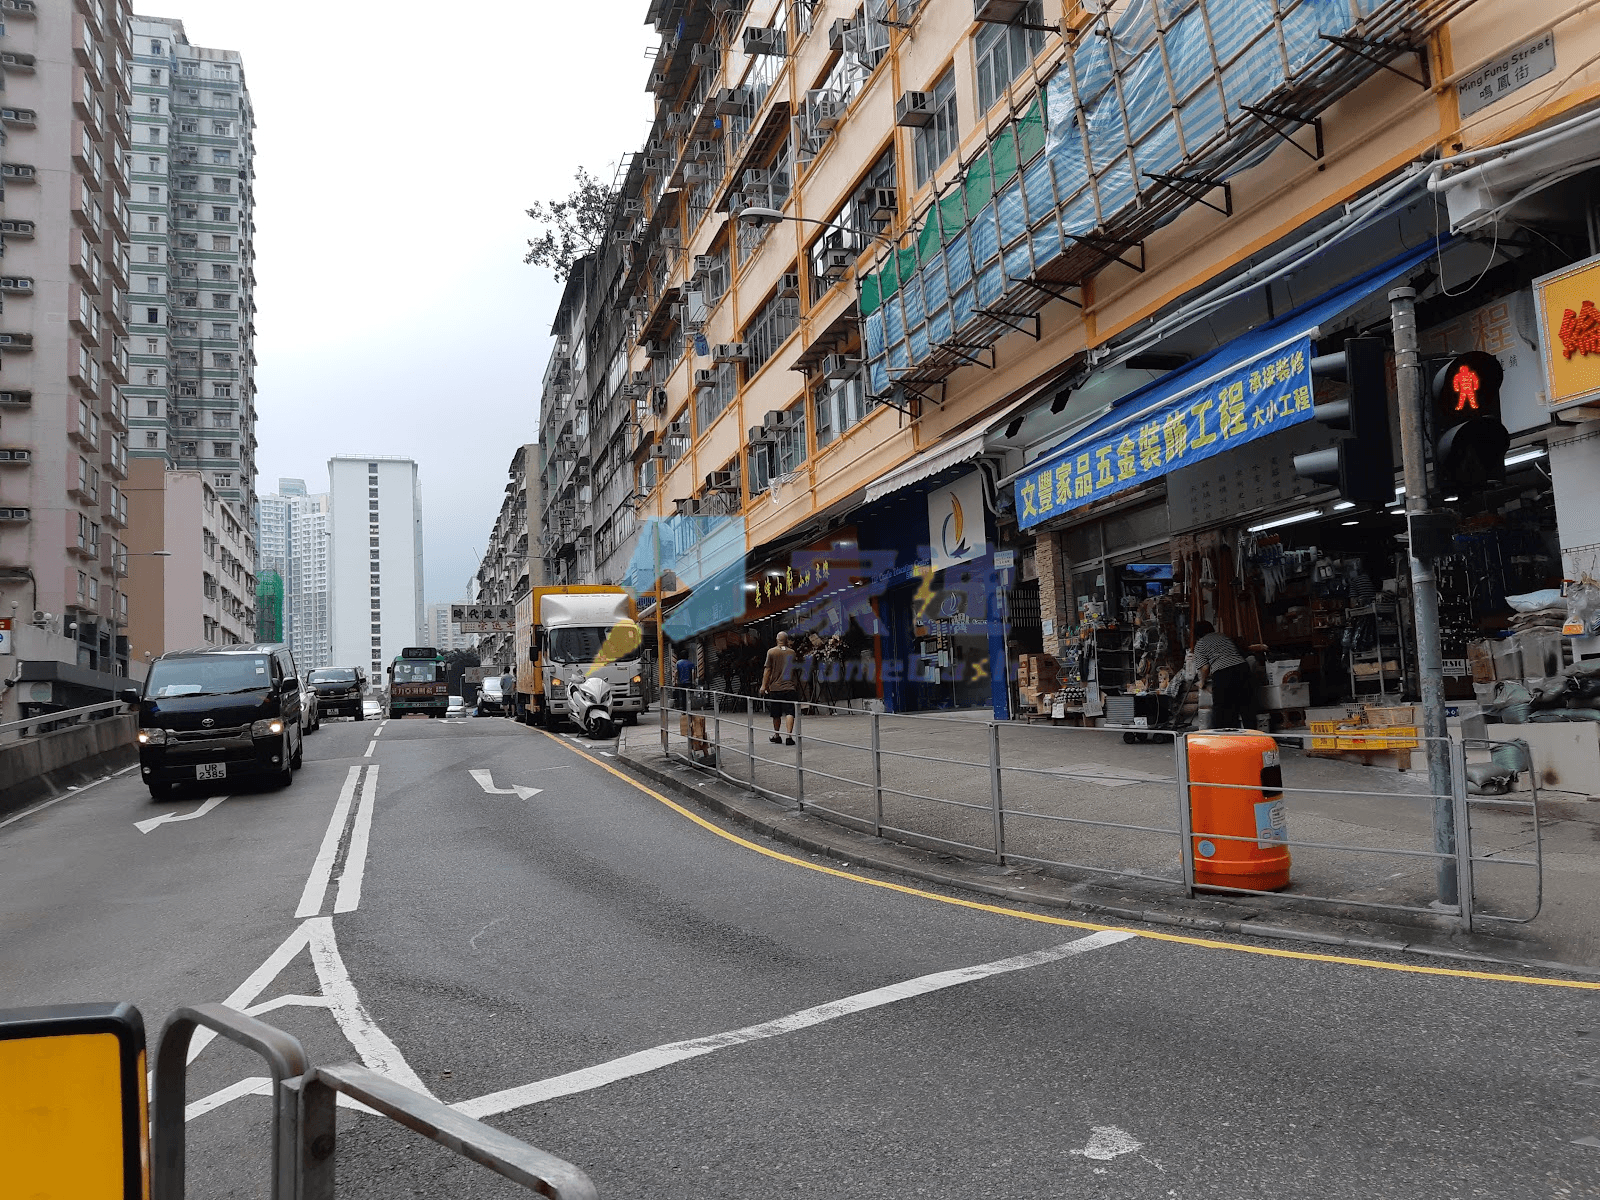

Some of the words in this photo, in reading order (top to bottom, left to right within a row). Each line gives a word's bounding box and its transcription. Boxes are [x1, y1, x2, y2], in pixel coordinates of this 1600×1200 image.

[1459, 76, 1483, 95] Ming
[1484, 60, 1509, 81] Fung
[1511, 37, 1550, 66] Street
[1479, 64, 1530, 100] 鳴鳳街
[1248, 350, 1305, 394] 承接裝修
[1252, 385, 1311, 430] 大小工程
[1020, 380, 1249, 520] 文豐家品五金裝飾工程
[199, 770, 225, 780] 2385
[204, 764, 217, 772] UR
